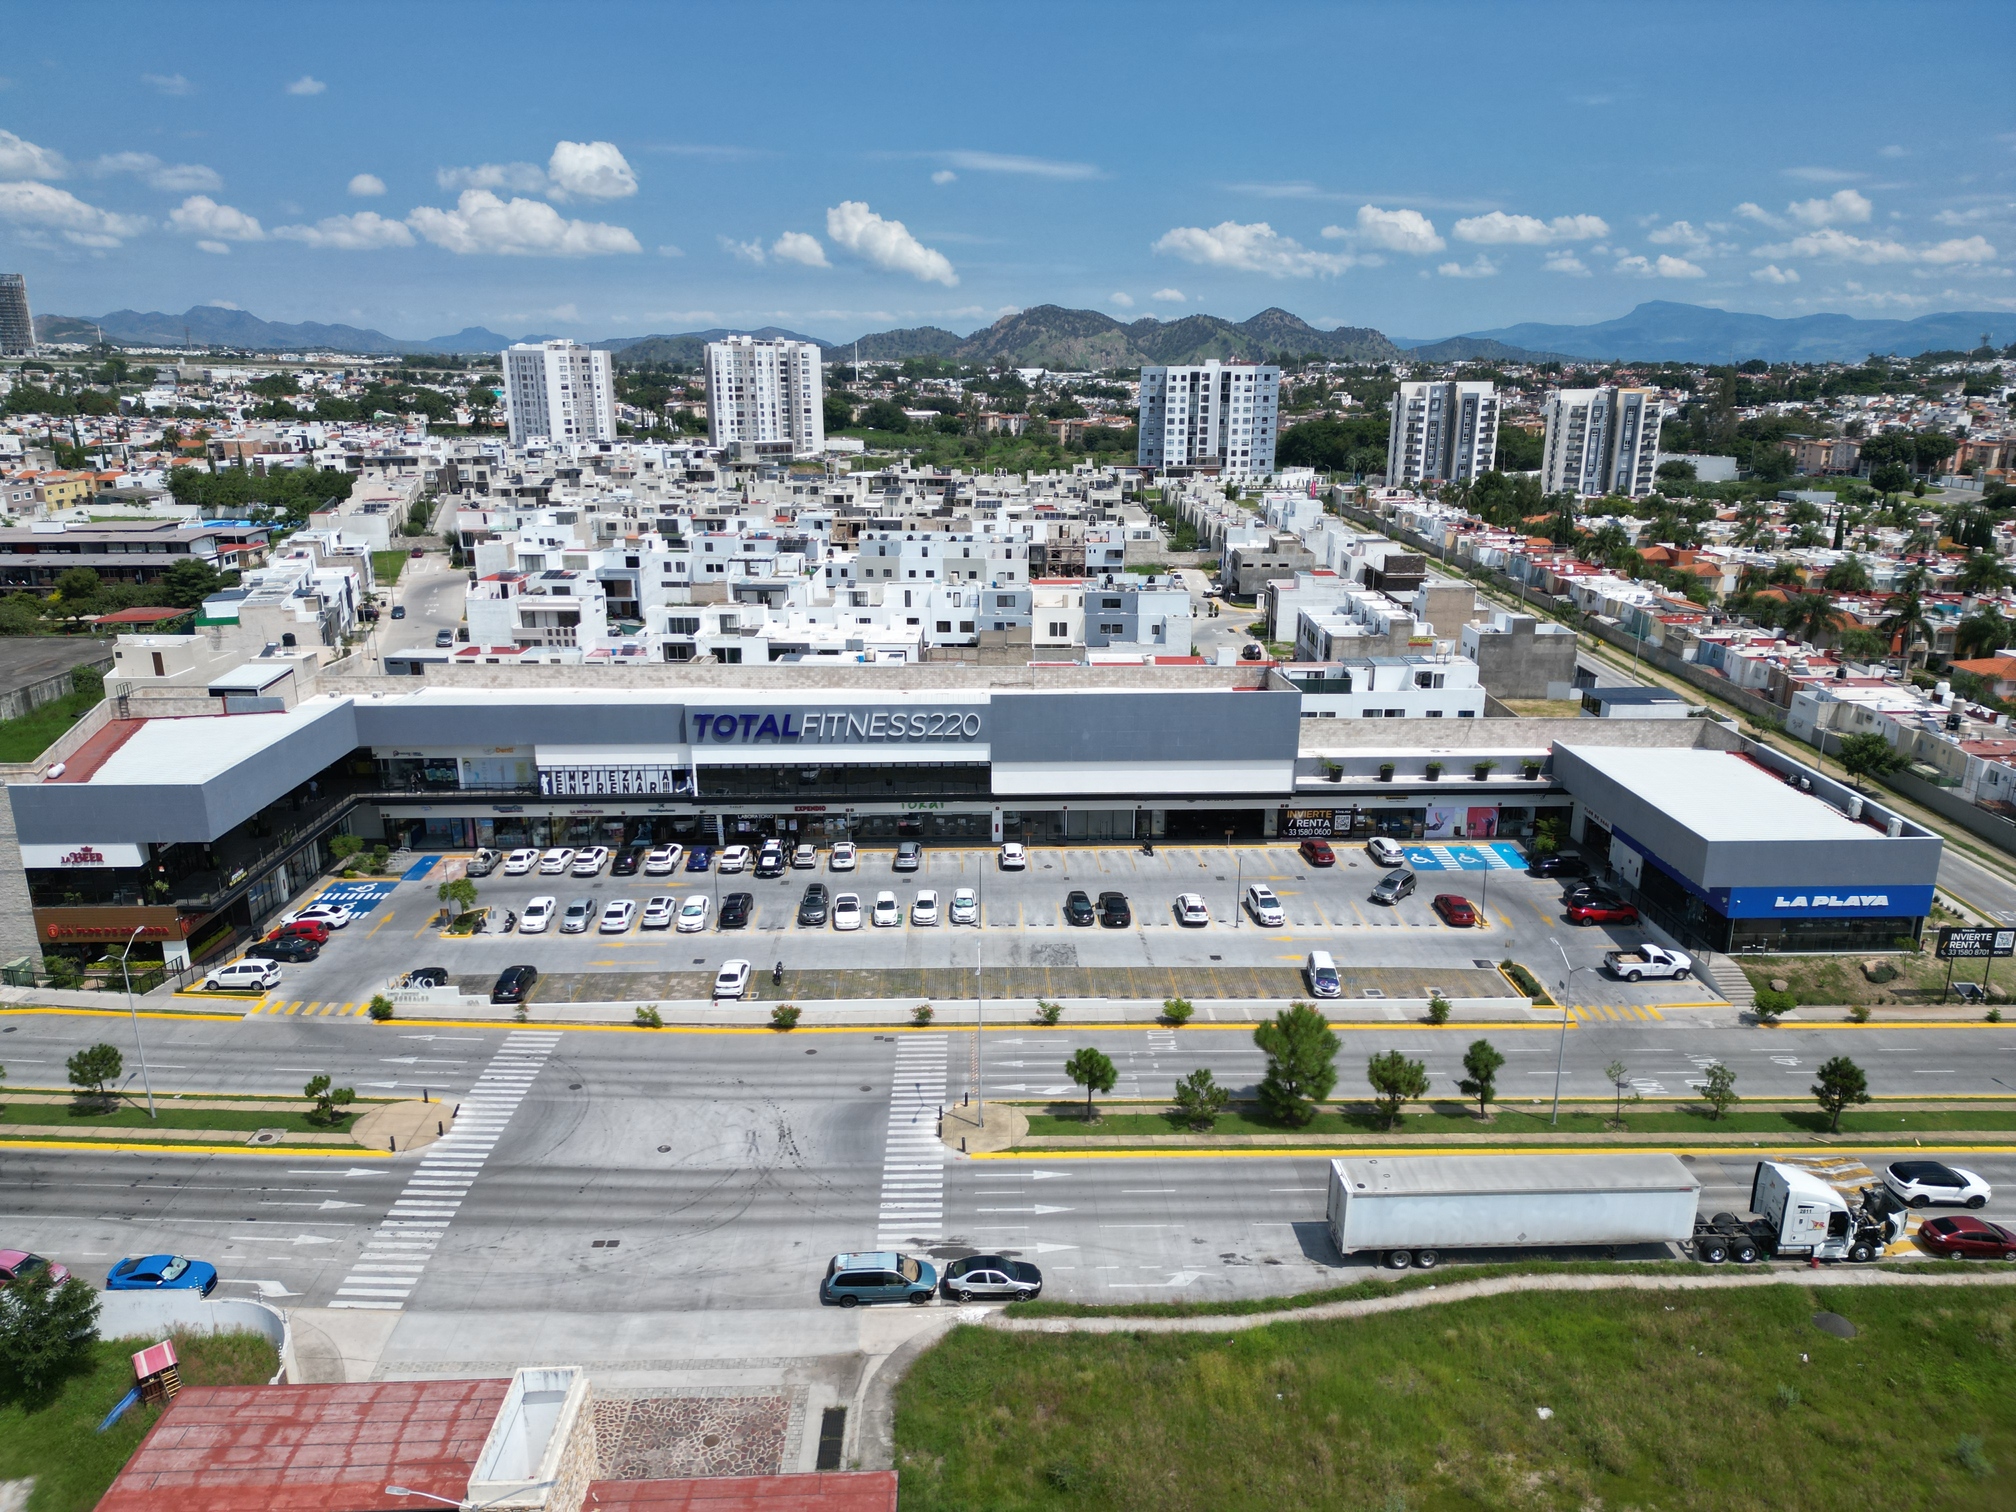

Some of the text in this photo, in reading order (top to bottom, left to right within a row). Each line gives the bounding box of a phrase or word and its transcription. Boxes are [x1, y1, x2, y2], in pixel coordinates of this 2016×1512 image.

[555, 770, 670, 782] EMPIEZA A
[1287, 810, 1332, 818] INVIERTE
[1296, 819, 1330, 827] RENTA
[69, 852, 104, 864] BEER
[1775, 896, 1889, 907] LA PLAYA
[1146, 1029, 1178, 1051] ALTO
